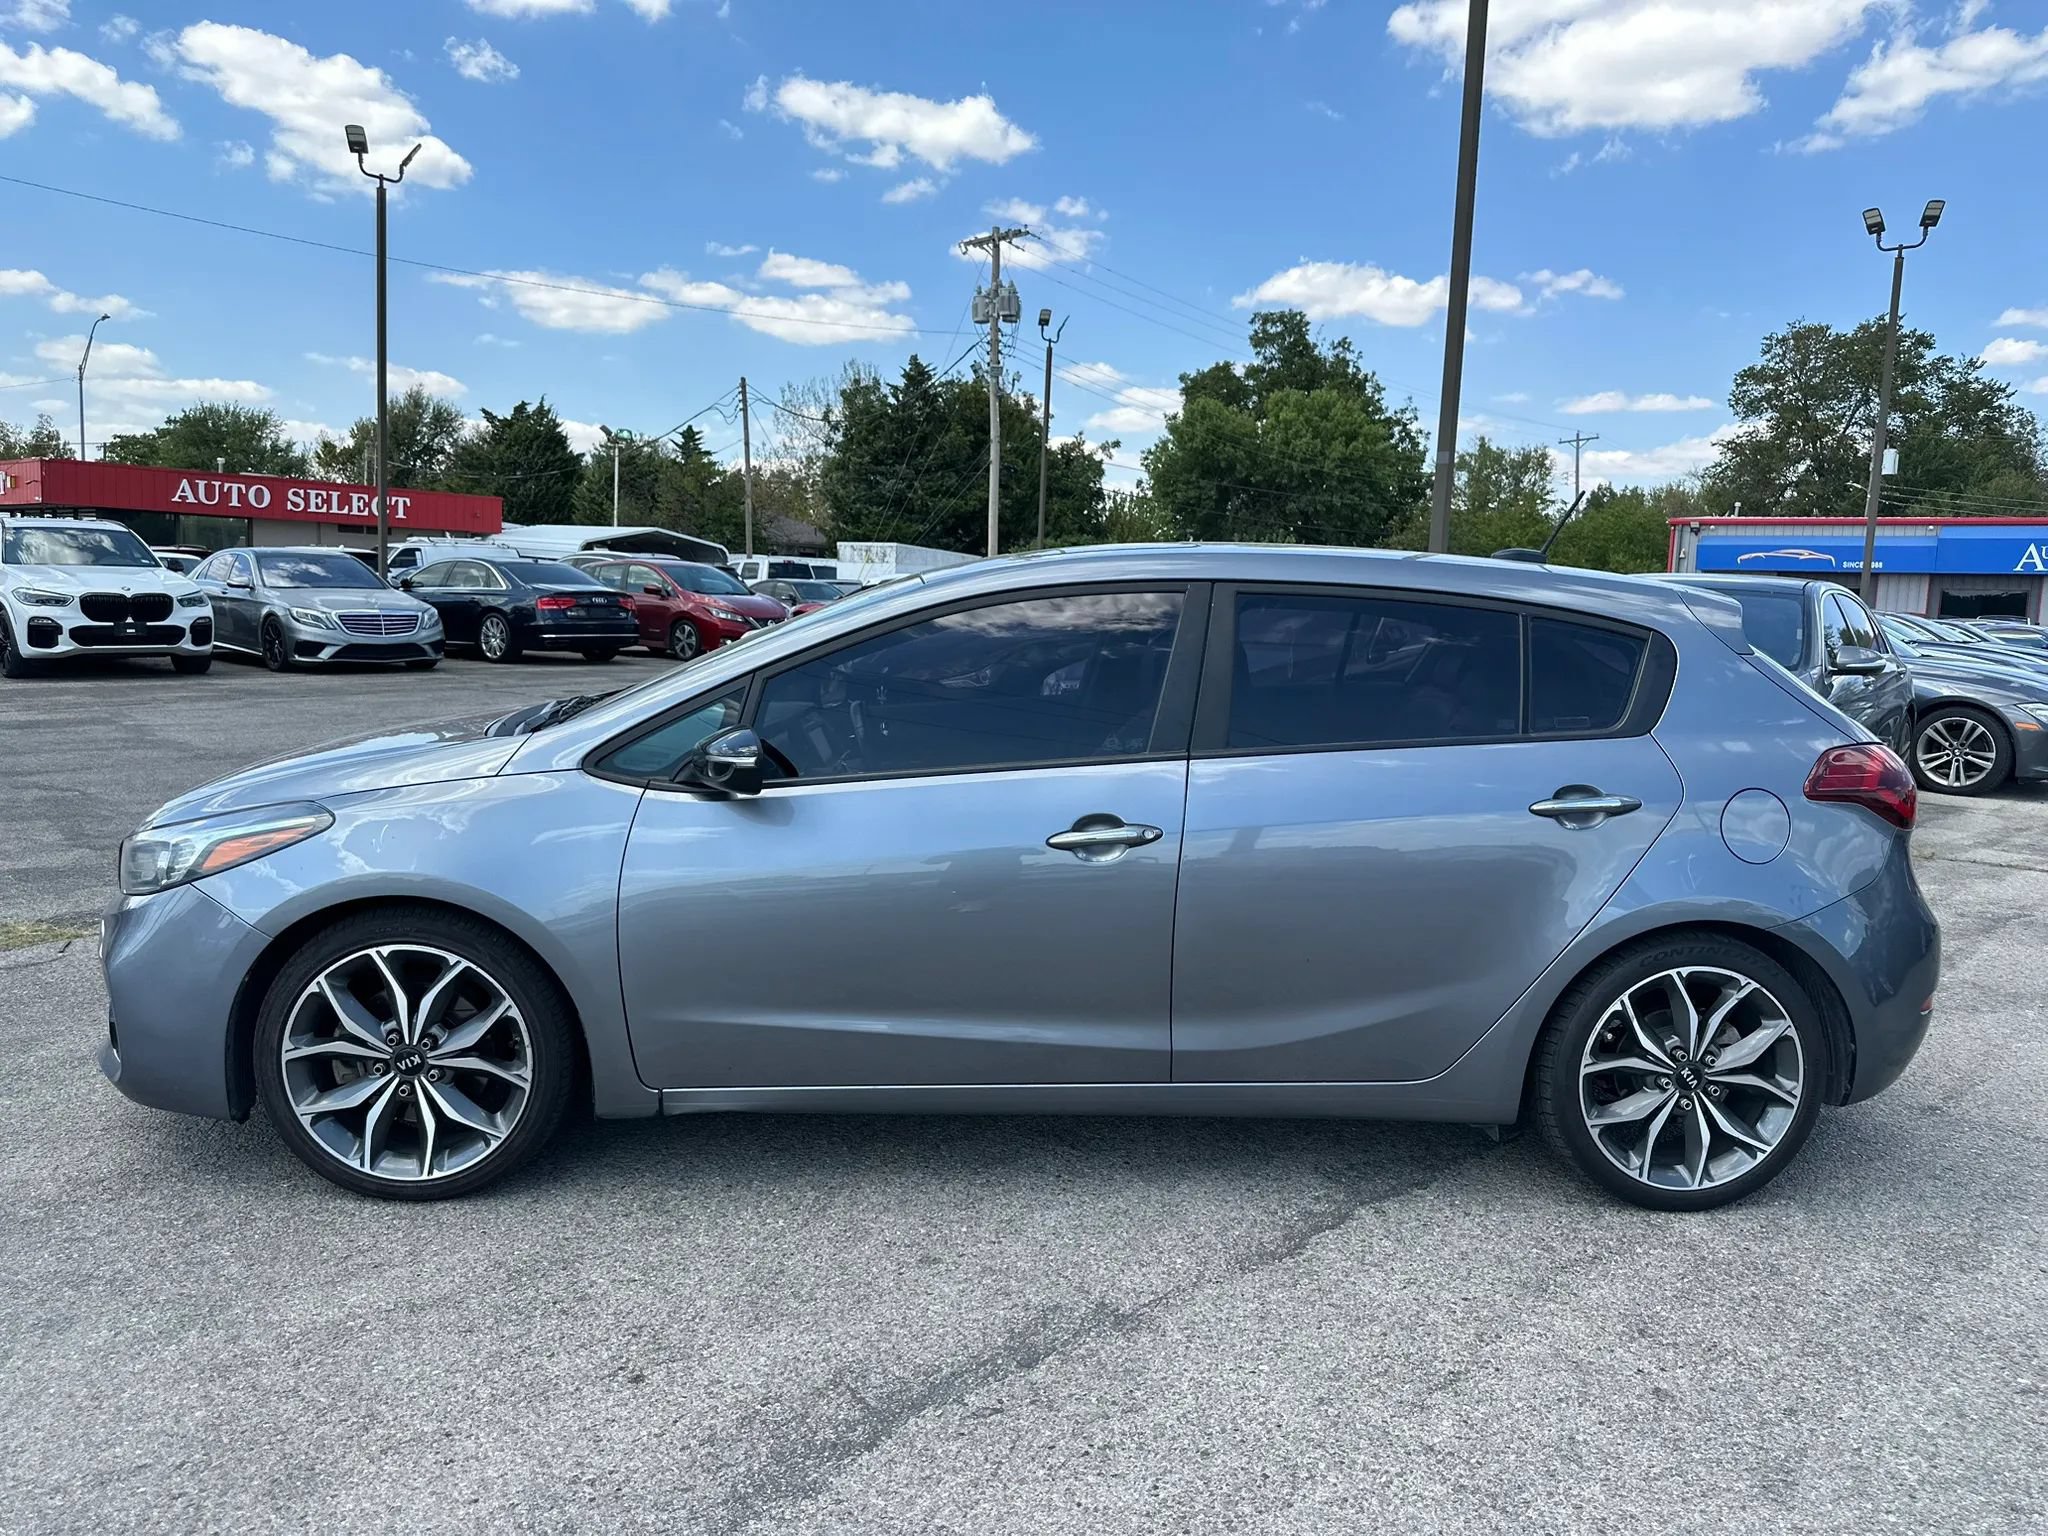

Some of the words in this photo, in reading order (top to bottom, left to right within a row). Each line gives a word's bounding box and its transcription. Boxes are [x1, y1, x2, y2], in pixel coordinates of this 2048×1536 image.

[172, 478, 272, 508] AUTO
[1842, 561, 1864, 569] SINCE
[396, 1054, 421, 1070] KIA
[1680, 1067, 1698, 1089] KIA
